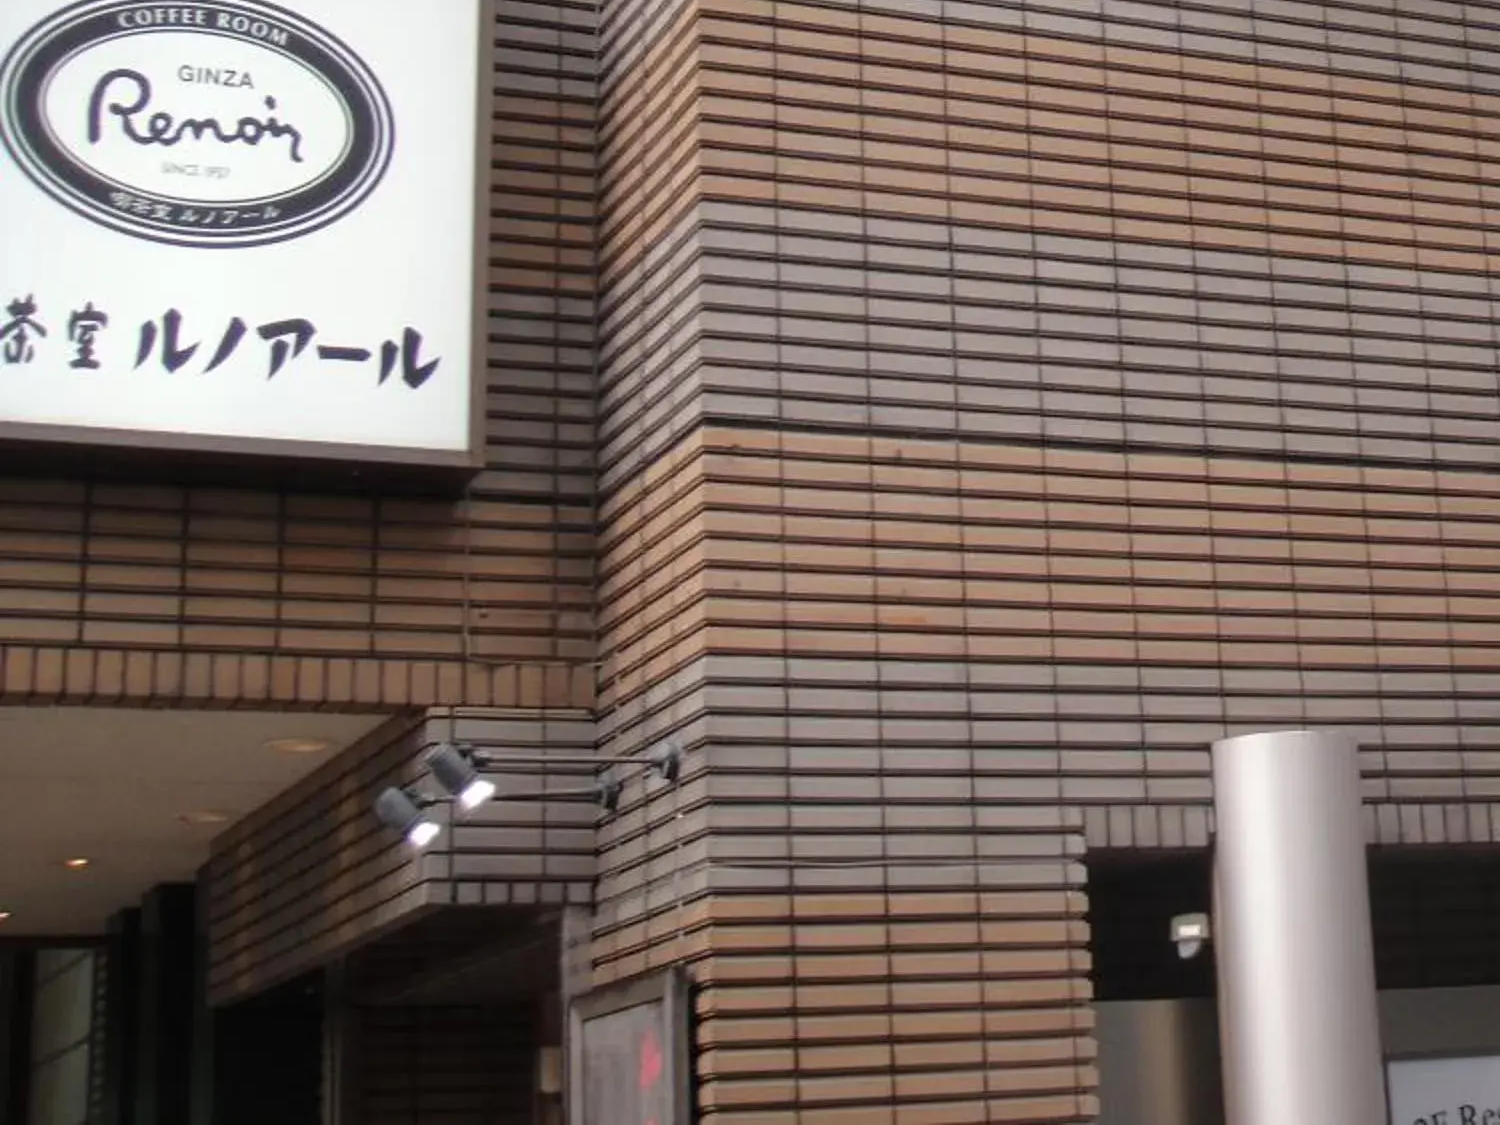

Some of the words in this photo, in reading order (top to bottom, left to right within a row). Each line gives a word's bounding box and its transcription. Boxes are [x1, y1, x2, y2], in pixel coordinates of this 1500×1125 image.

[117, 7, 207, 28] COFFEE
[215, 11, 289, 47] ROOM
[177, 63, 255, 89] GINZA
[86, 68, 305, 163] Renoir
